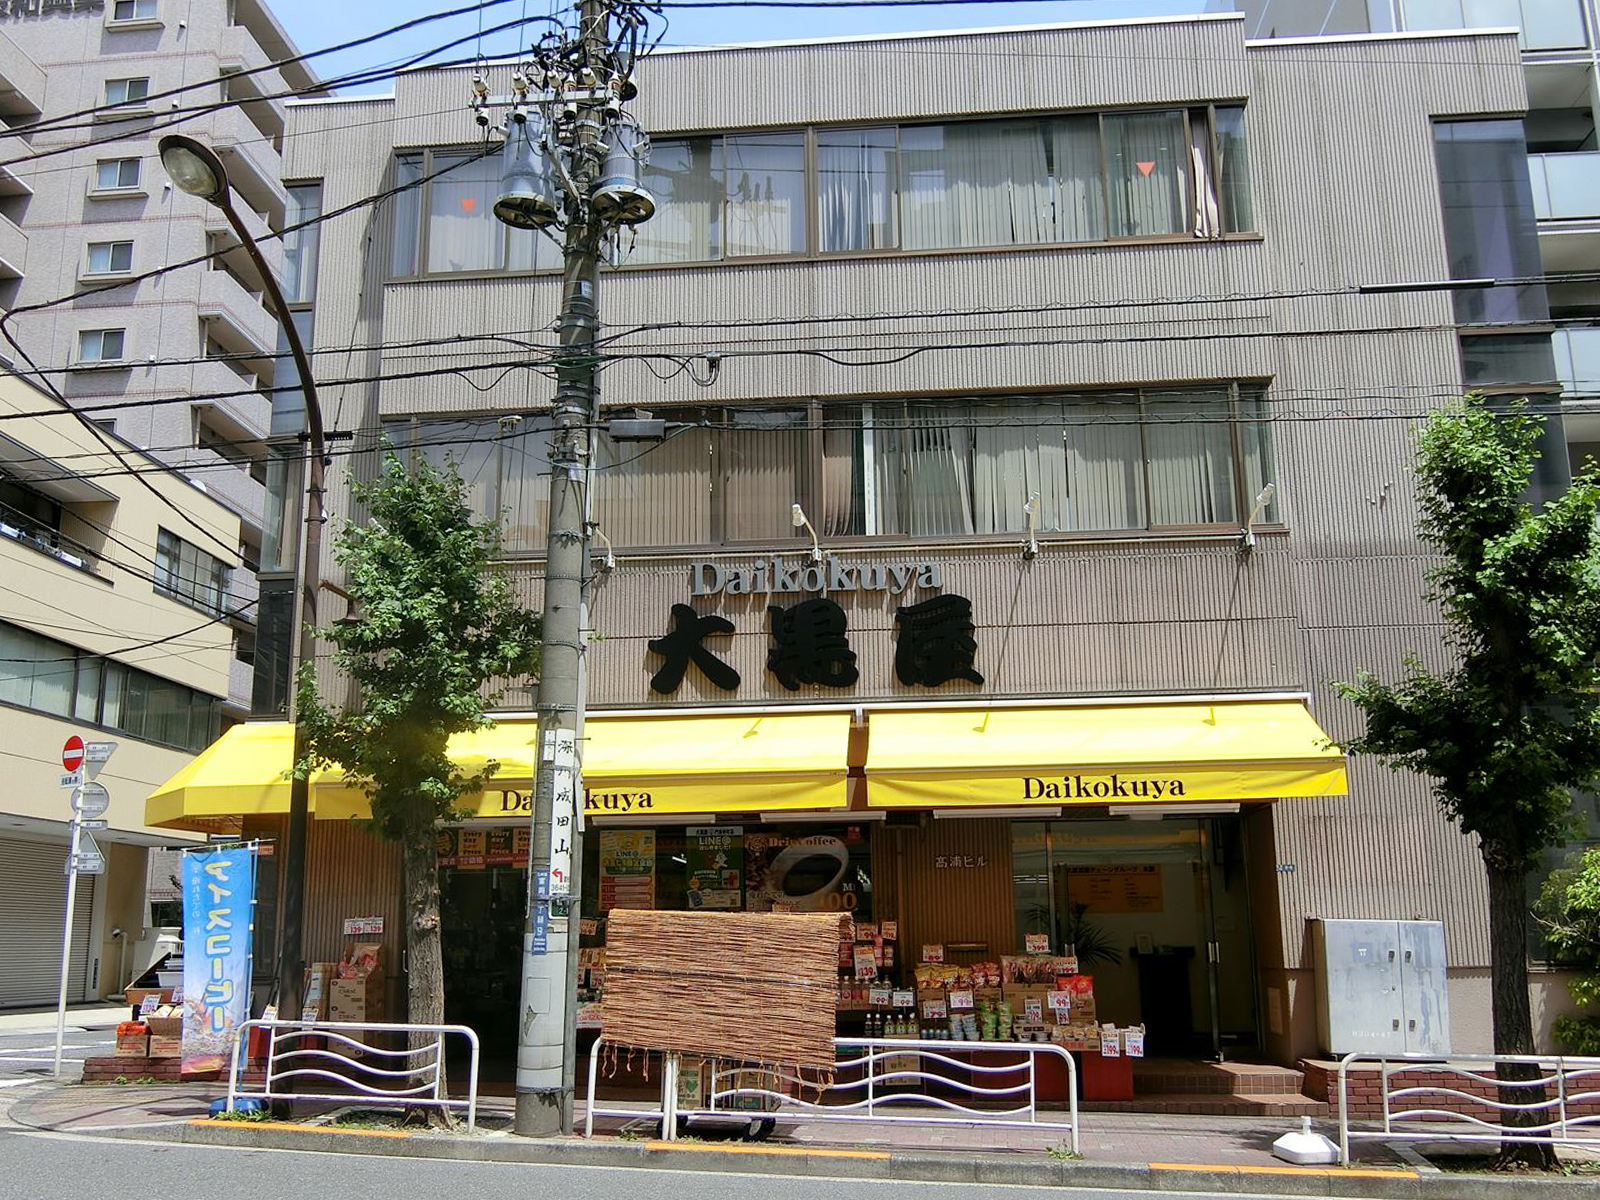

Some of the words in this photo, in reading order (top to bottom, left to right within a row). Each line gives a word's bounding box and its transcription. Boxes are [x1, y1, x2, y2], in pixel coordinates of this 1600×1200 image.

[691, 556, 943, 596] Daikokuya
[648, 594, 984, 694] 大黒屋
[1023, 774, 1186, 799] Daikokuya
[501, 788, 654, 812] Dakuya
[699, 836, 732, 846] LINE@
